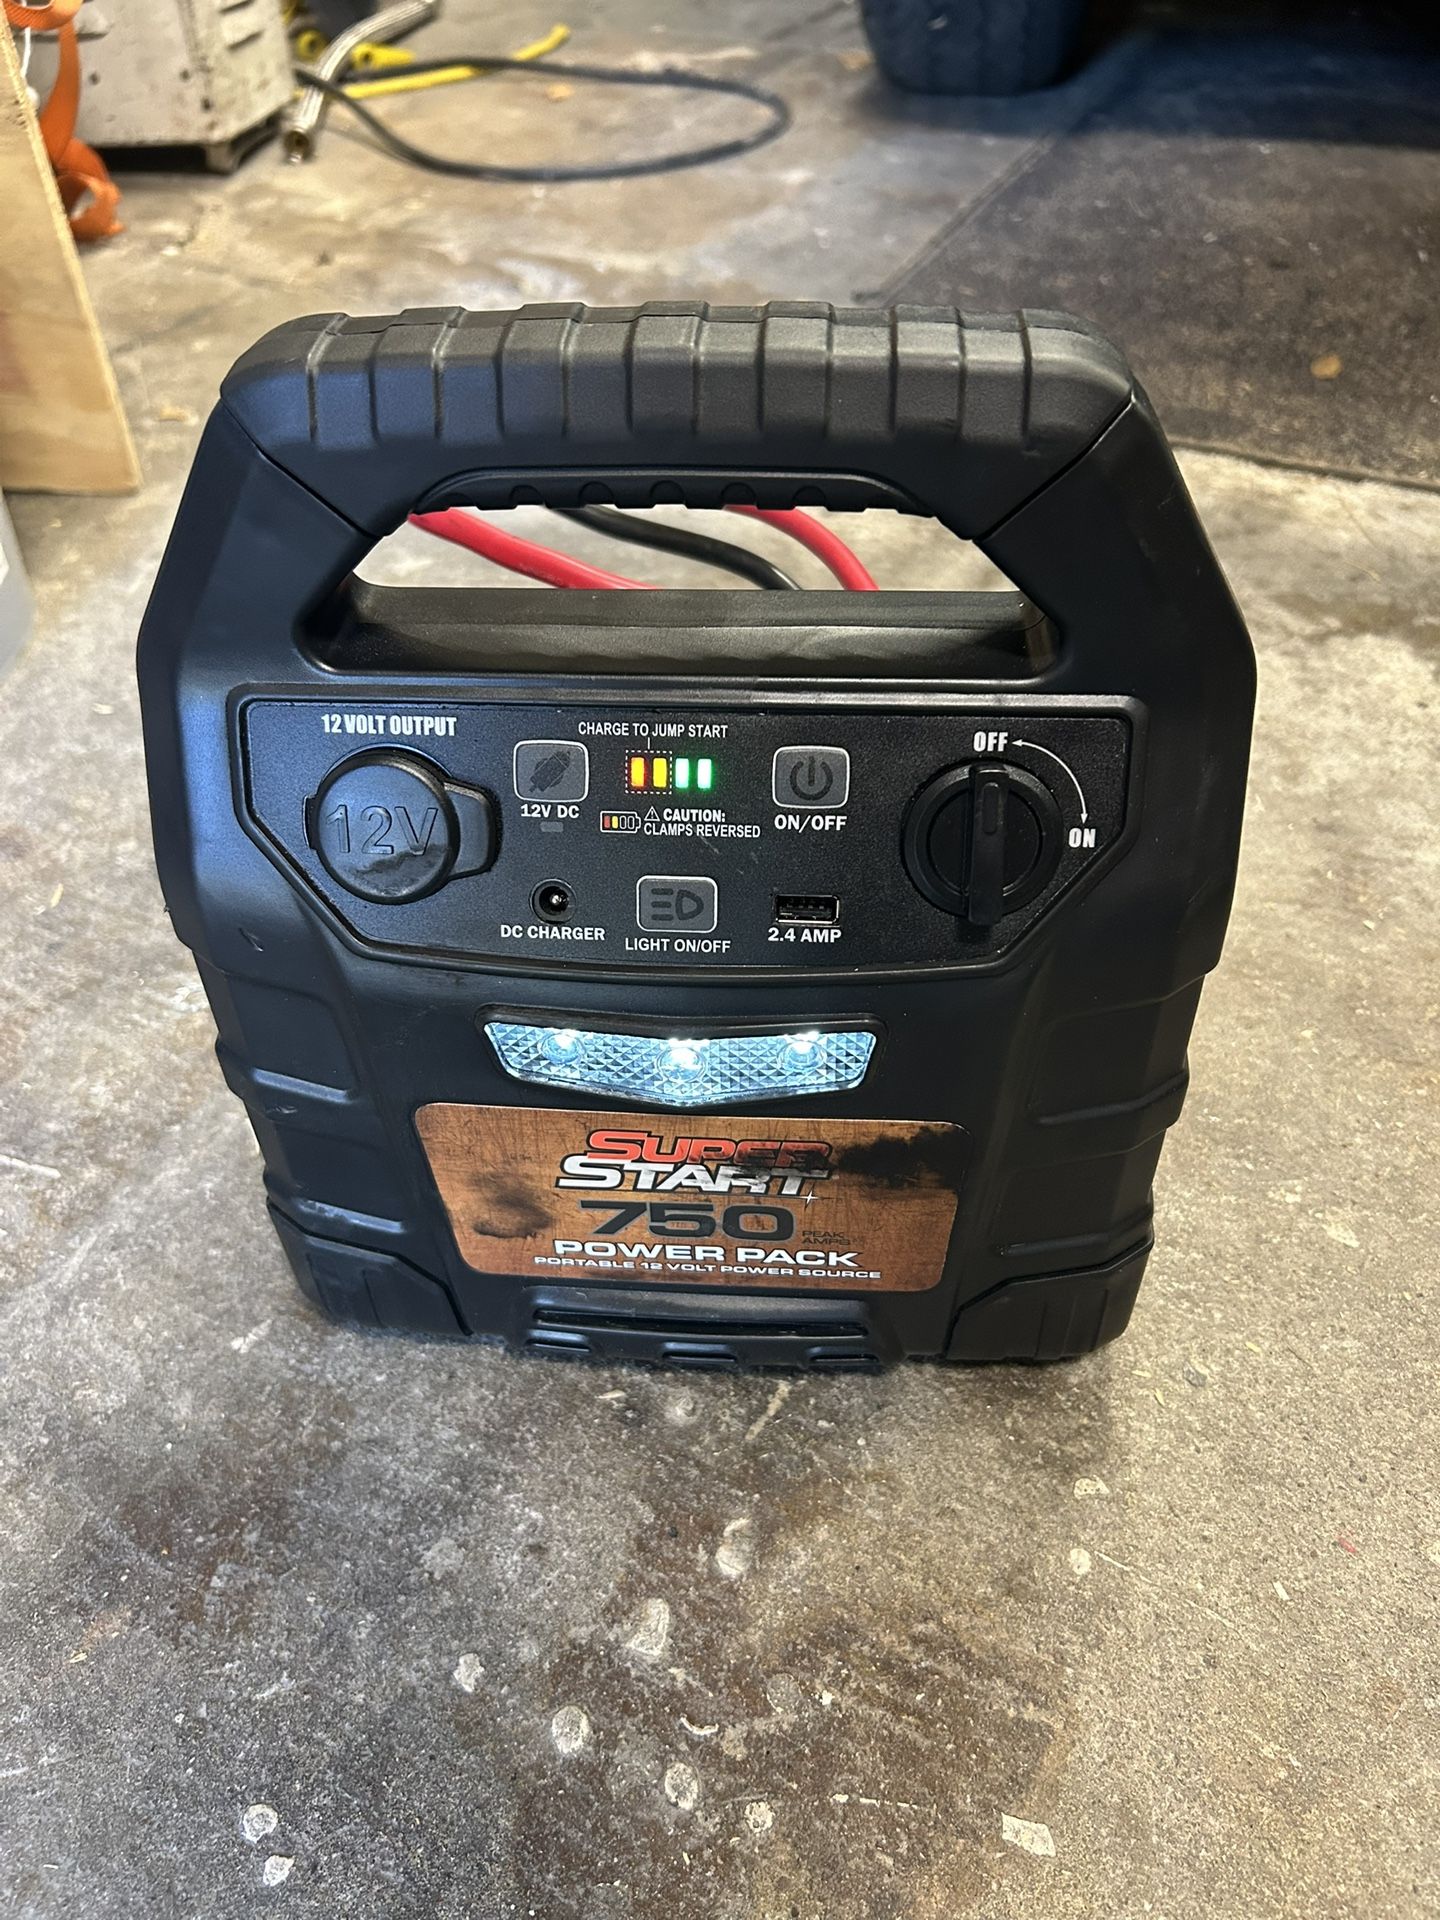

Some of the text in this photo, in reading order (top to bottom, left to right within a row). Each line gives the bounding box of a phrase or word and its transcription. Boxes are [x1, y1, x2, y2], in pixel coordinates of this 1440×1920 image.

[321, 715, 457, 737] 12 VOLT OUTPUT
[578, 721, 728, 739] CHARGE TO JUMP START
[973, 731, 1009, 752] OFF
[521, 804, 580, 819] 12V DC
[663, 809, 726, 823] CAUTION:
[325, 804, 439, 856] 12V
[644, 822, 761, 839] CLAMPS REVERSED
[774, 815, 847, 833] ON/OFF
[1069, 828, 1096, 848] ON
[500, 925, 606, 942] DC CHARGER
[768, 928, 842, 943] 2.4 AMP
[625, 938, 732, 954] LIGHT ON/OFF
[587, 1129, 833, 1168] SUPER
[555, 1153, 830, 1194] START
[580, 1200, 794, 1241] 750
[802, 1230, 844, 1239] PEAK
[554, 1240, 862, 1267] POWER PACK
[534, 1256, 881, 1279] PORTABLE 12 VOLT POWER SOURCE
